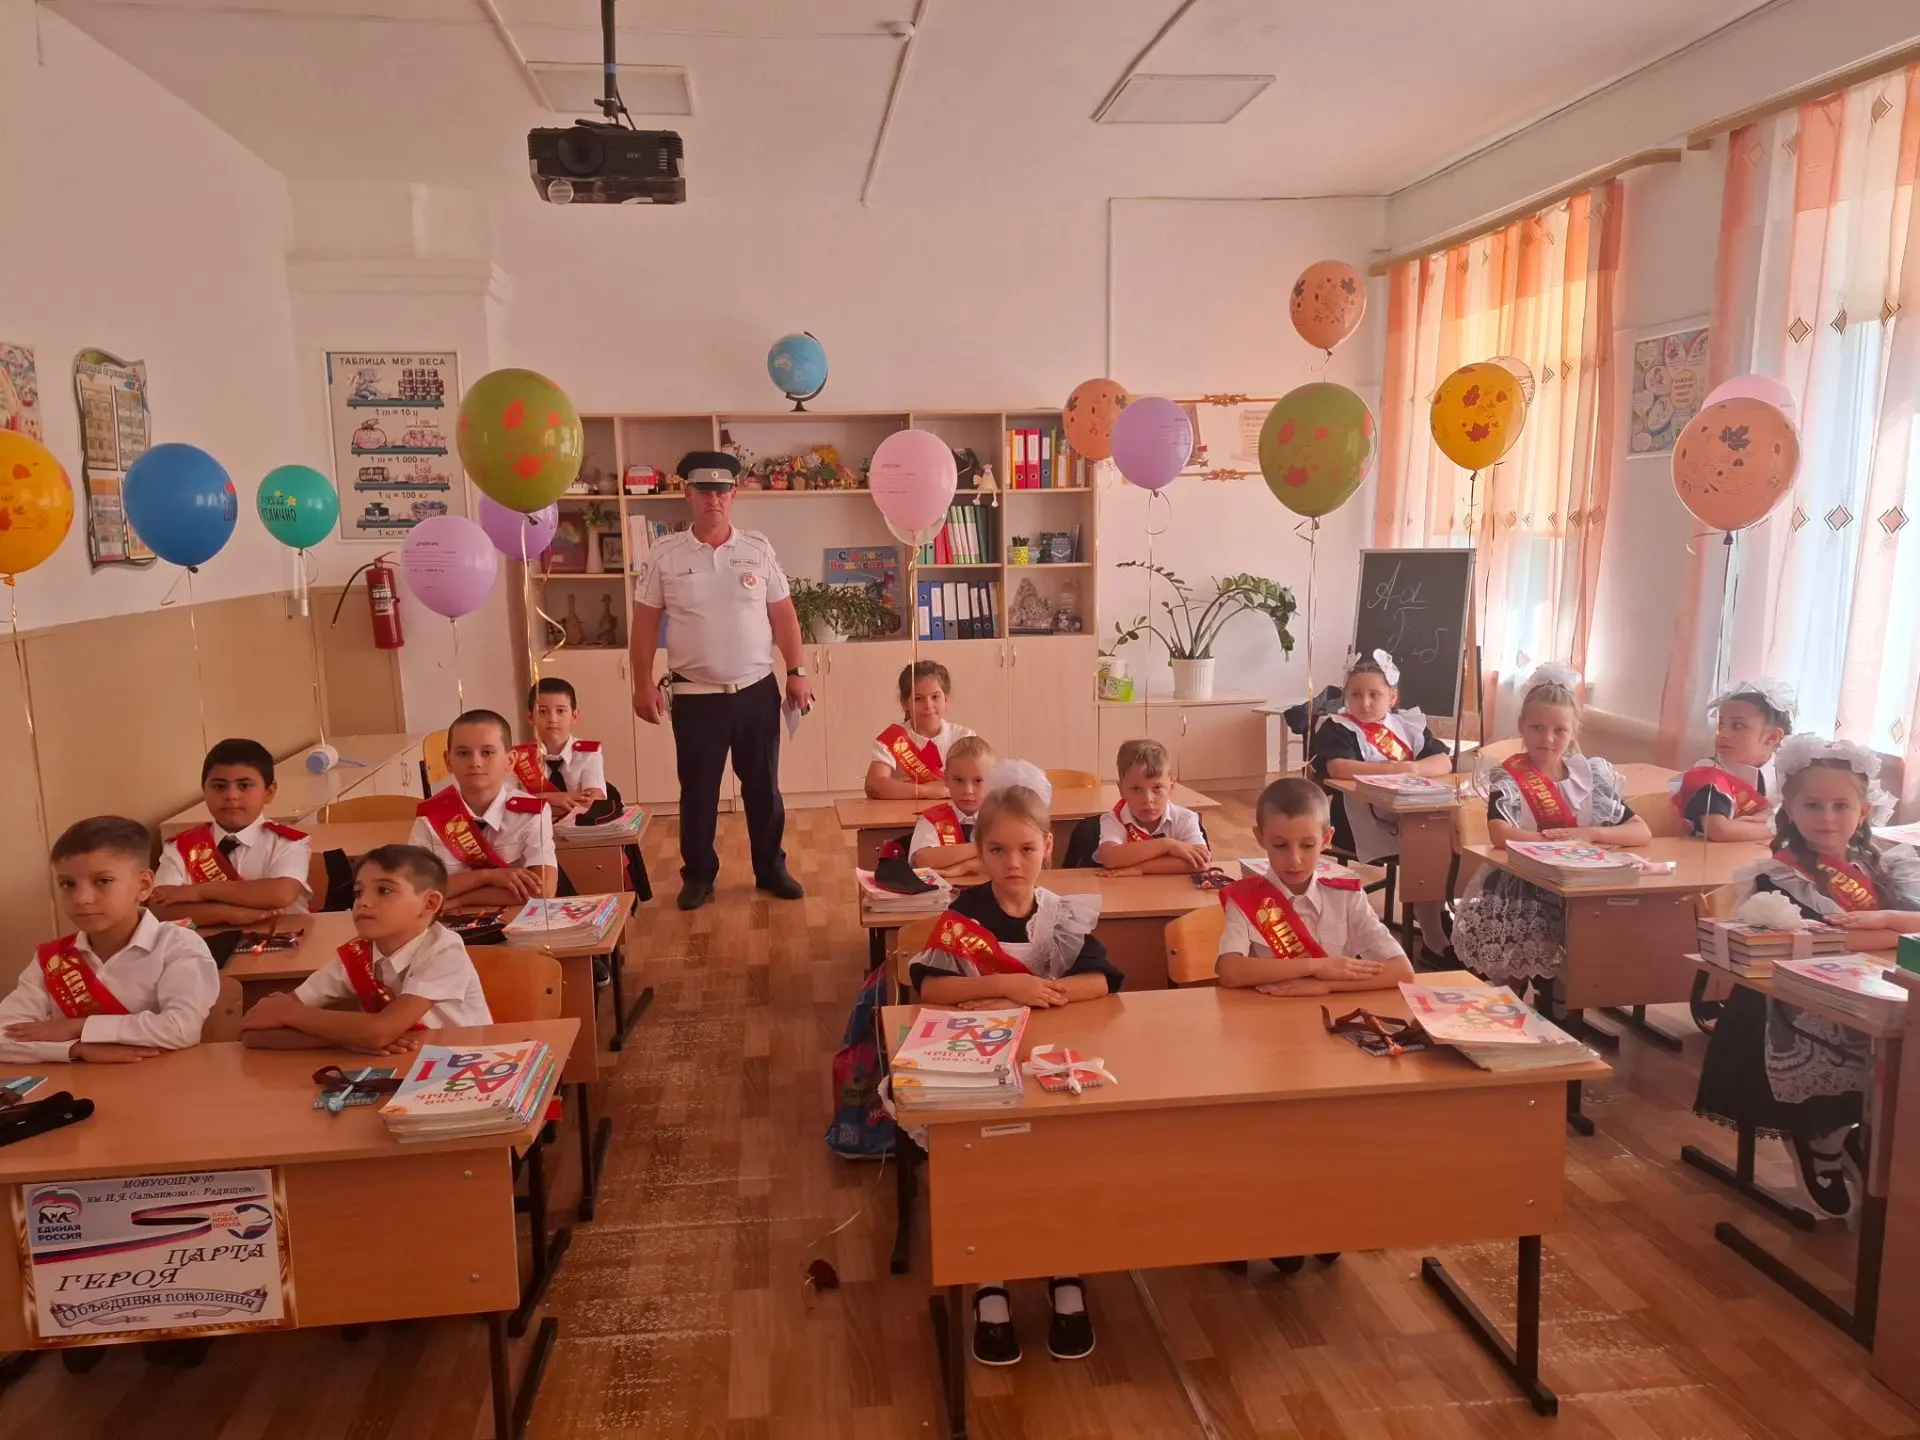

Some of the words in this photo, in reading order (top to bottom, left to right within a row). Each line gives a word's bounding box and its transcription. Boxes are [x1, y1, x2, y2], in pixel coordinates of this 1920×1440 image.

[339, 357, 386, 366] ТАБЛИЦА
[392, 357, 413, 366] МЕР
[419, 357, 446, 366] ВЕСА
[203, 1185, 256, 1197] Радищево
[37, 1224, 82, 1235] ЕДИНАЯ
[37, 1231, 82, 1242] РОССИЯ
[165, 1243, 266, 1267] ПАРТА
[55, 1267, 183, 1292] ГЕРОЯ
[165, 1291, 257, 1308] поколения
